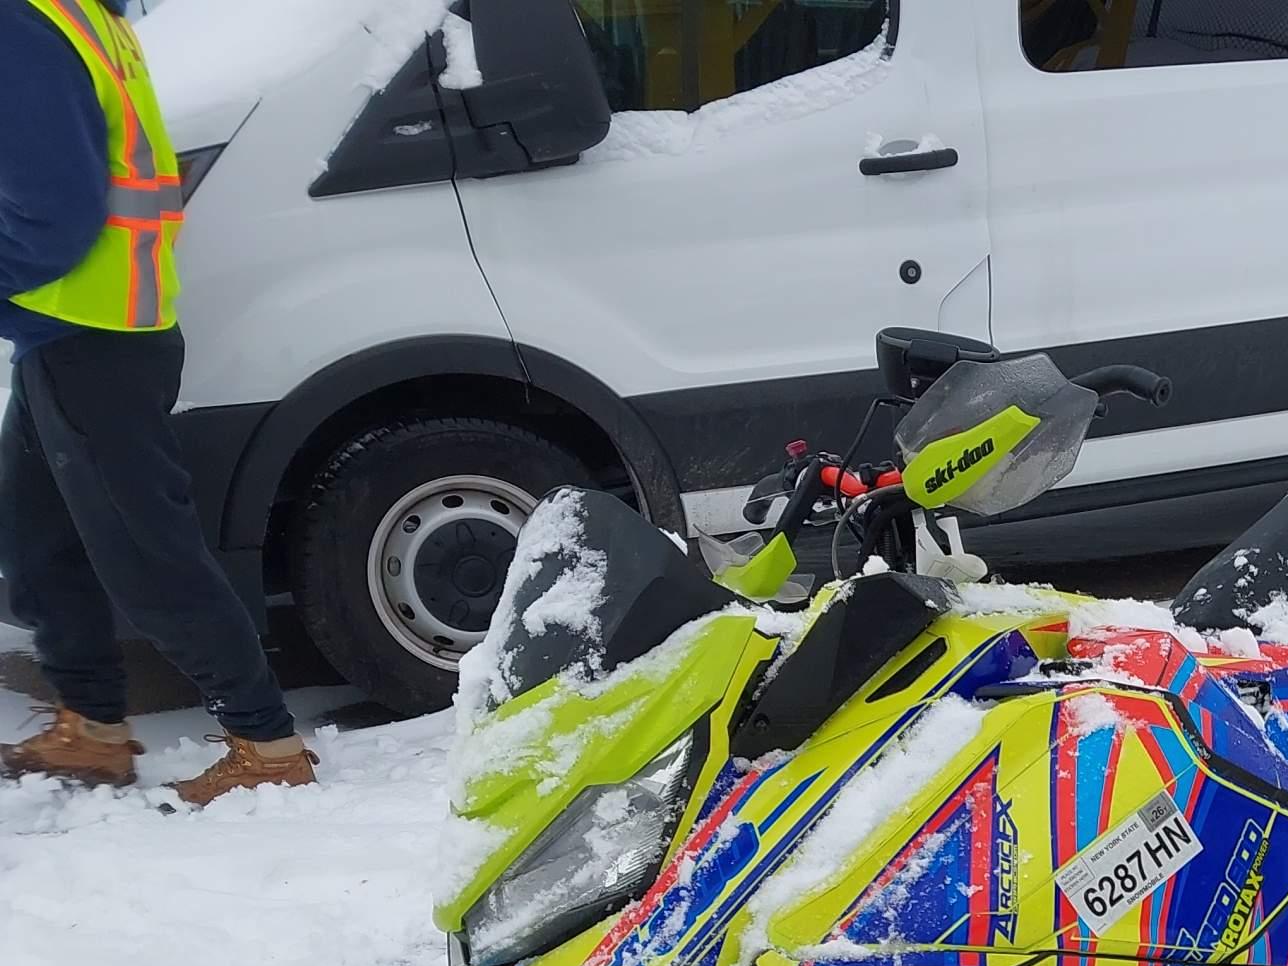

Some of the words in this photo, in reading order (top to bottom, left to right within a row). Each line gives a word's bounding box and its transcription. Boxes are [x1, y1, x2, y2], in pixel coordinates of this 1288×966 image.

[924, 437, 995, 494] ski-doo
[1090, 850, 1106, 862] NEW
[1104, 837, 1123, 853] YORK
[1121, 822, 1139, 840] STATE
[1126, 872, 1165, 905] SNOWMOBILE
[1221, 869, 1265, 949] ROTAX
[1252, 838, 1269, 873] POWER
